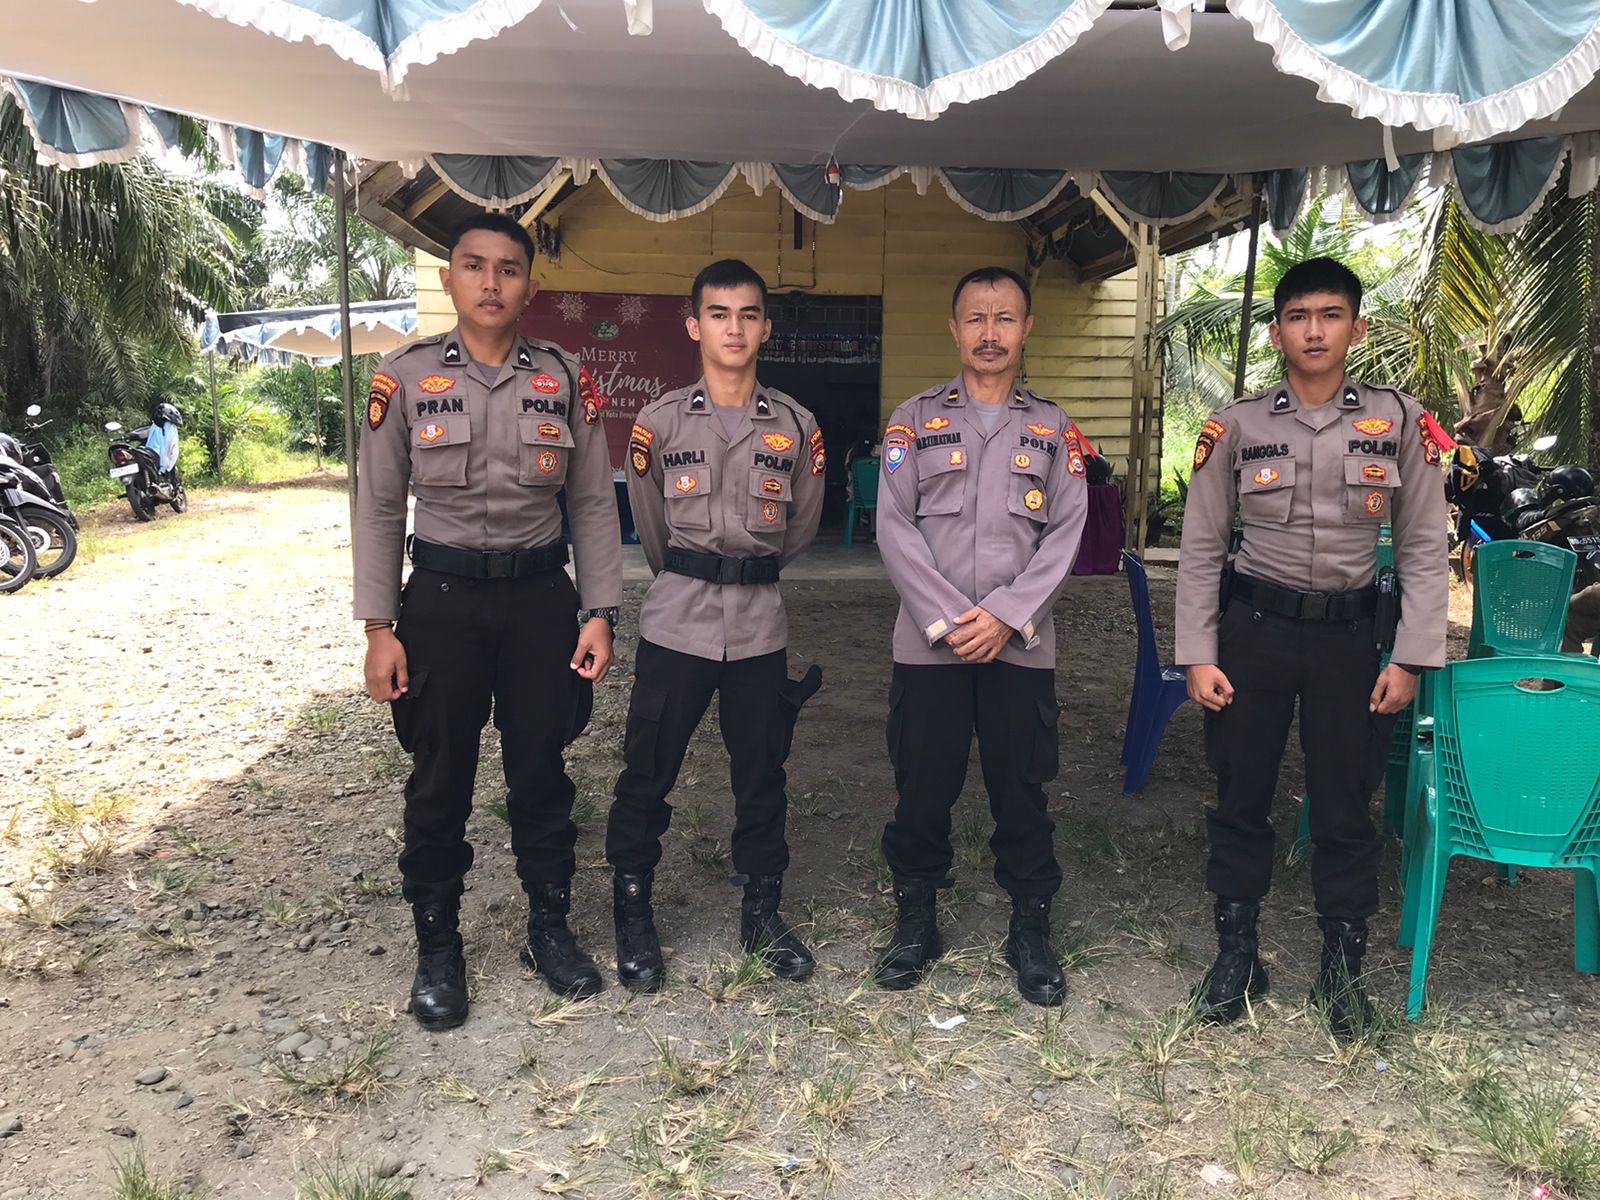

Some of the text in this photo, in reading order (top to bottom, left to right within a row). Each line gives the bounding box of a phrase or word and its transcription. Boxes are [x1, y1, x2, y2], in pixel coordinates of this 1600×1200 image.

[581, 347, 638, 364] MERRY
[592, 363, 667, 398] stmas
[416, 398, 464, 417] PRAN
[522, 398, 566, 417] POLRI
[611, 397, 635, 407] NEW
[1019, 436, 1058, 458] POLRI
[1349, 439, 1397, 457] POLRI
[663, 450, 705, 468] HARLI
[754, 453, 793, 472] POLRI
